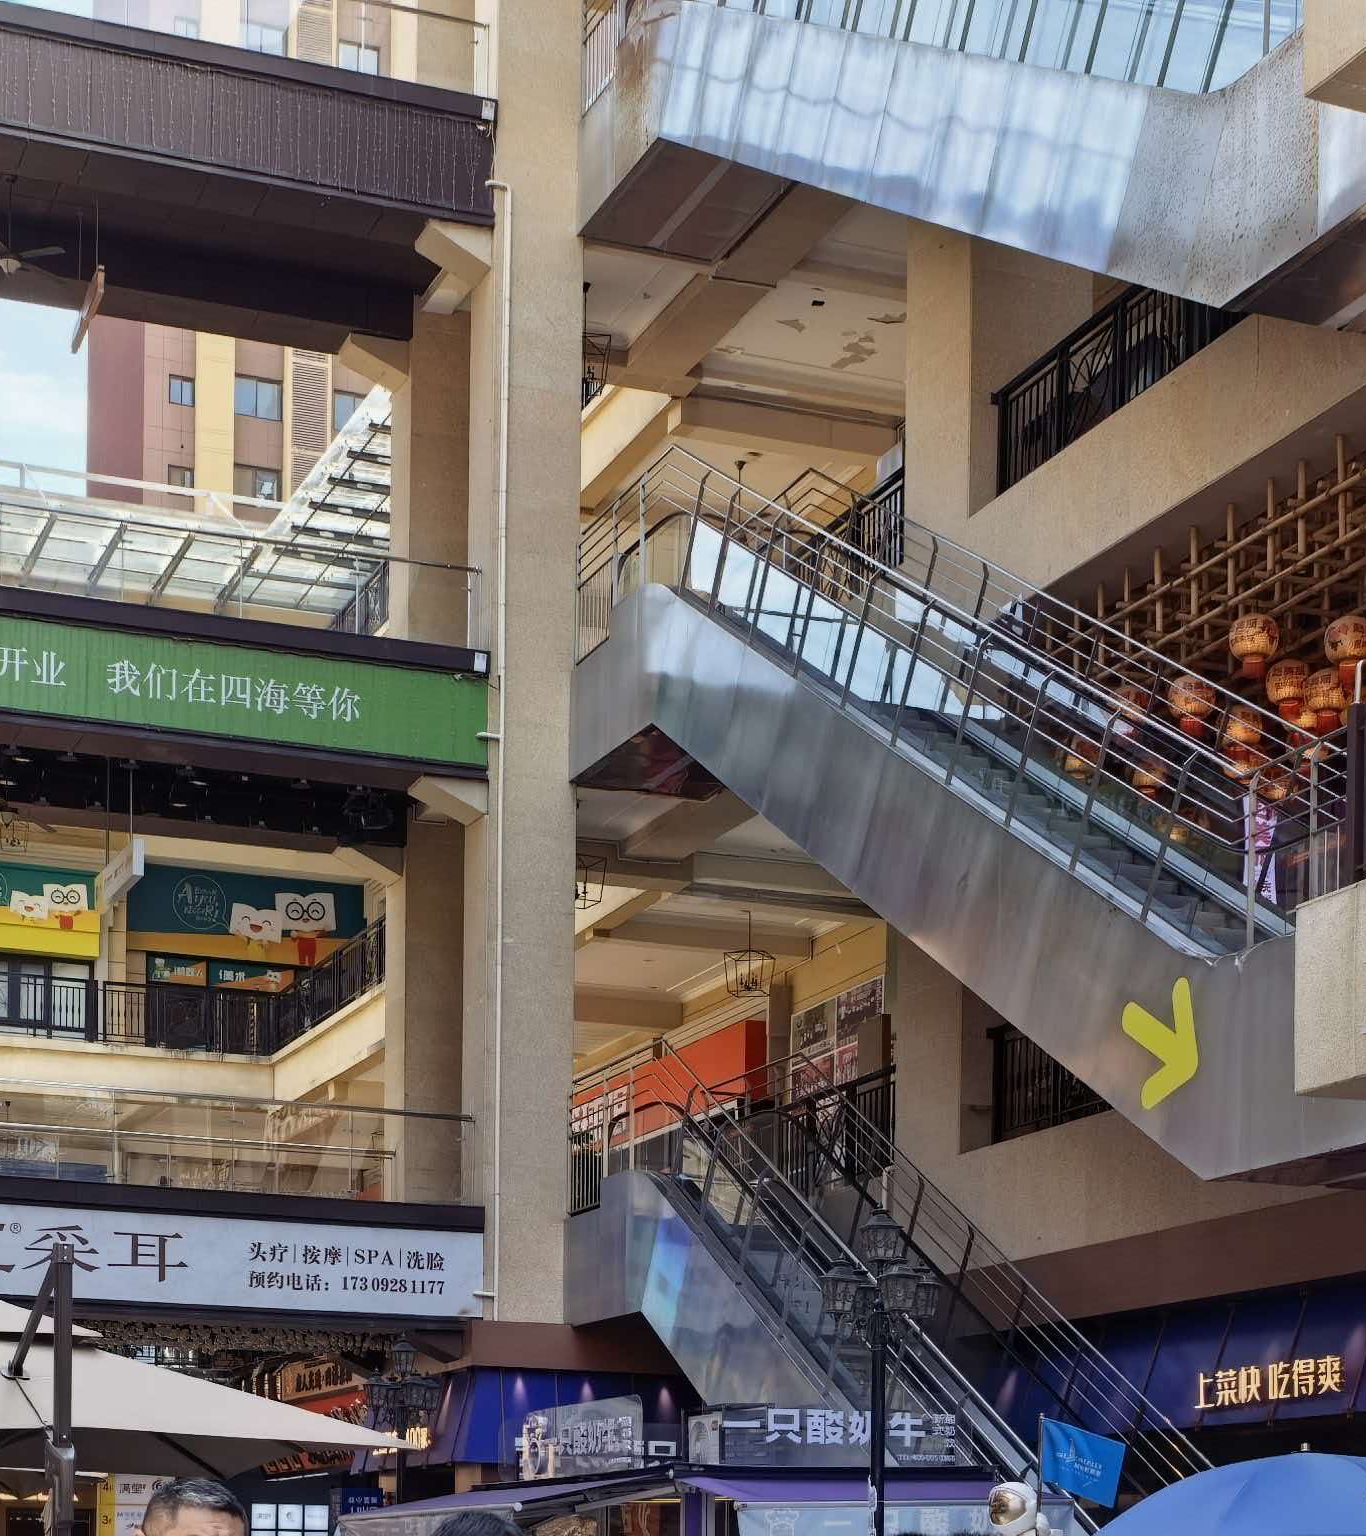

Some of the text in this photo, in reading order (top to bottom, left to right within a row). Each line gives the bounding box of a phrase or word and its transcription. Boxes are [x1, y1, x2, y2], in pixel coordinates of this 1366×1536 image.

[106, 659, 362, 722] 我们在四海等你
[249, 1241, 444, 1272] 头疗 按摩 SPA 洗脸
[1194, 1355, 1346, 1409] 上菜快 吃得爽
